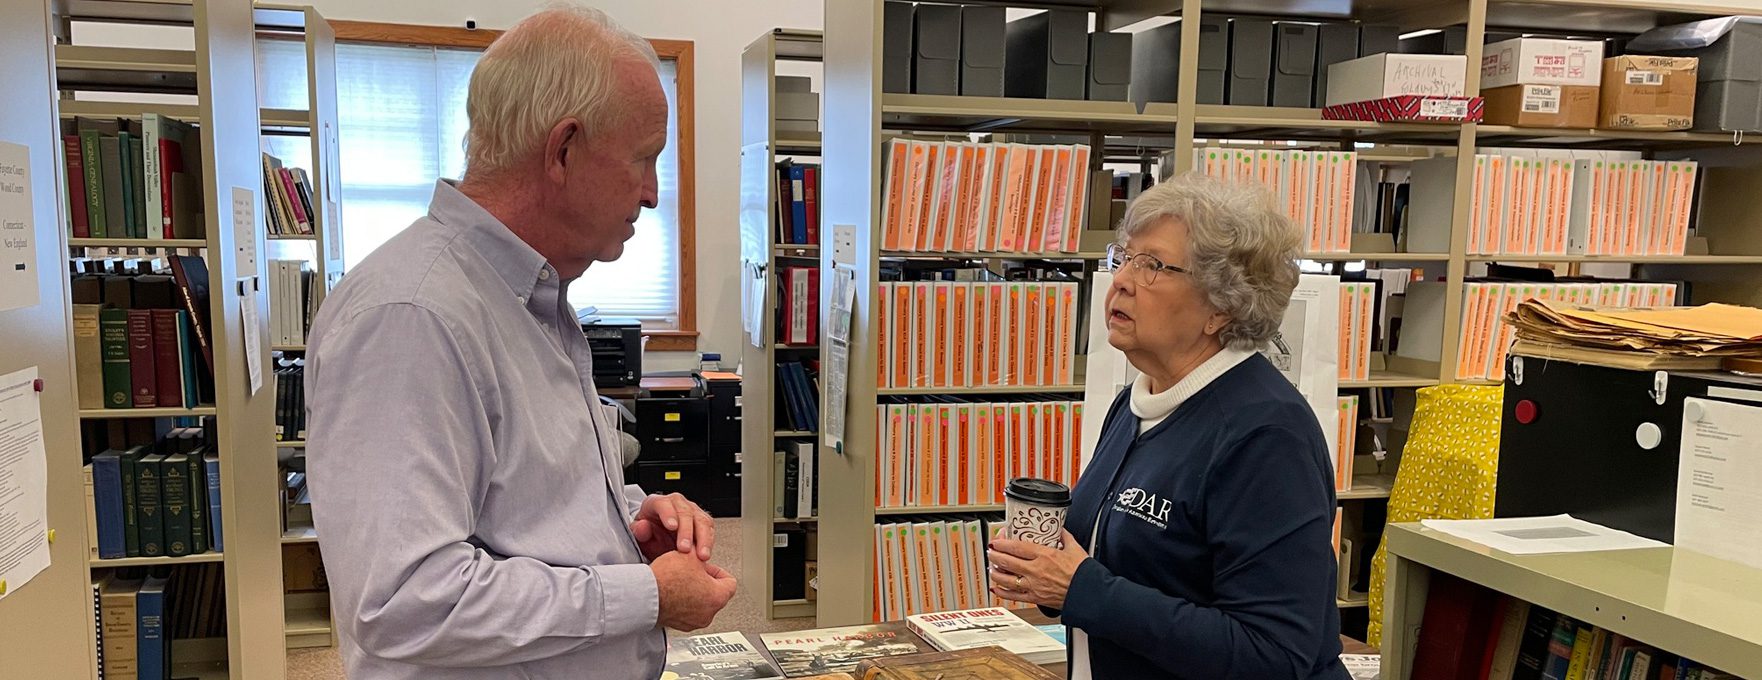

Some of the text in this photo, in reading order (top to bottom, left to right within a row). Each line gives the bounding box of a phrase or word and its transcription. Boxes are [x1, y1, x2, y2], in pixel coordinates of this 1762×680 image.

[1393, 62, 1446, 82] ARCHIVAL
[86, 137, 95, 165] VIRGINIA
[90, 167, 98, 206] GENEALOGY
[1129, 488, 1172, 522] DAR
[920, 612, 966, 622] SILENT
[967, 609, 1005, 618] ONES
[832, 632, 897, 641] HARBOR
[688, 644, 748, 656] HARBOR
